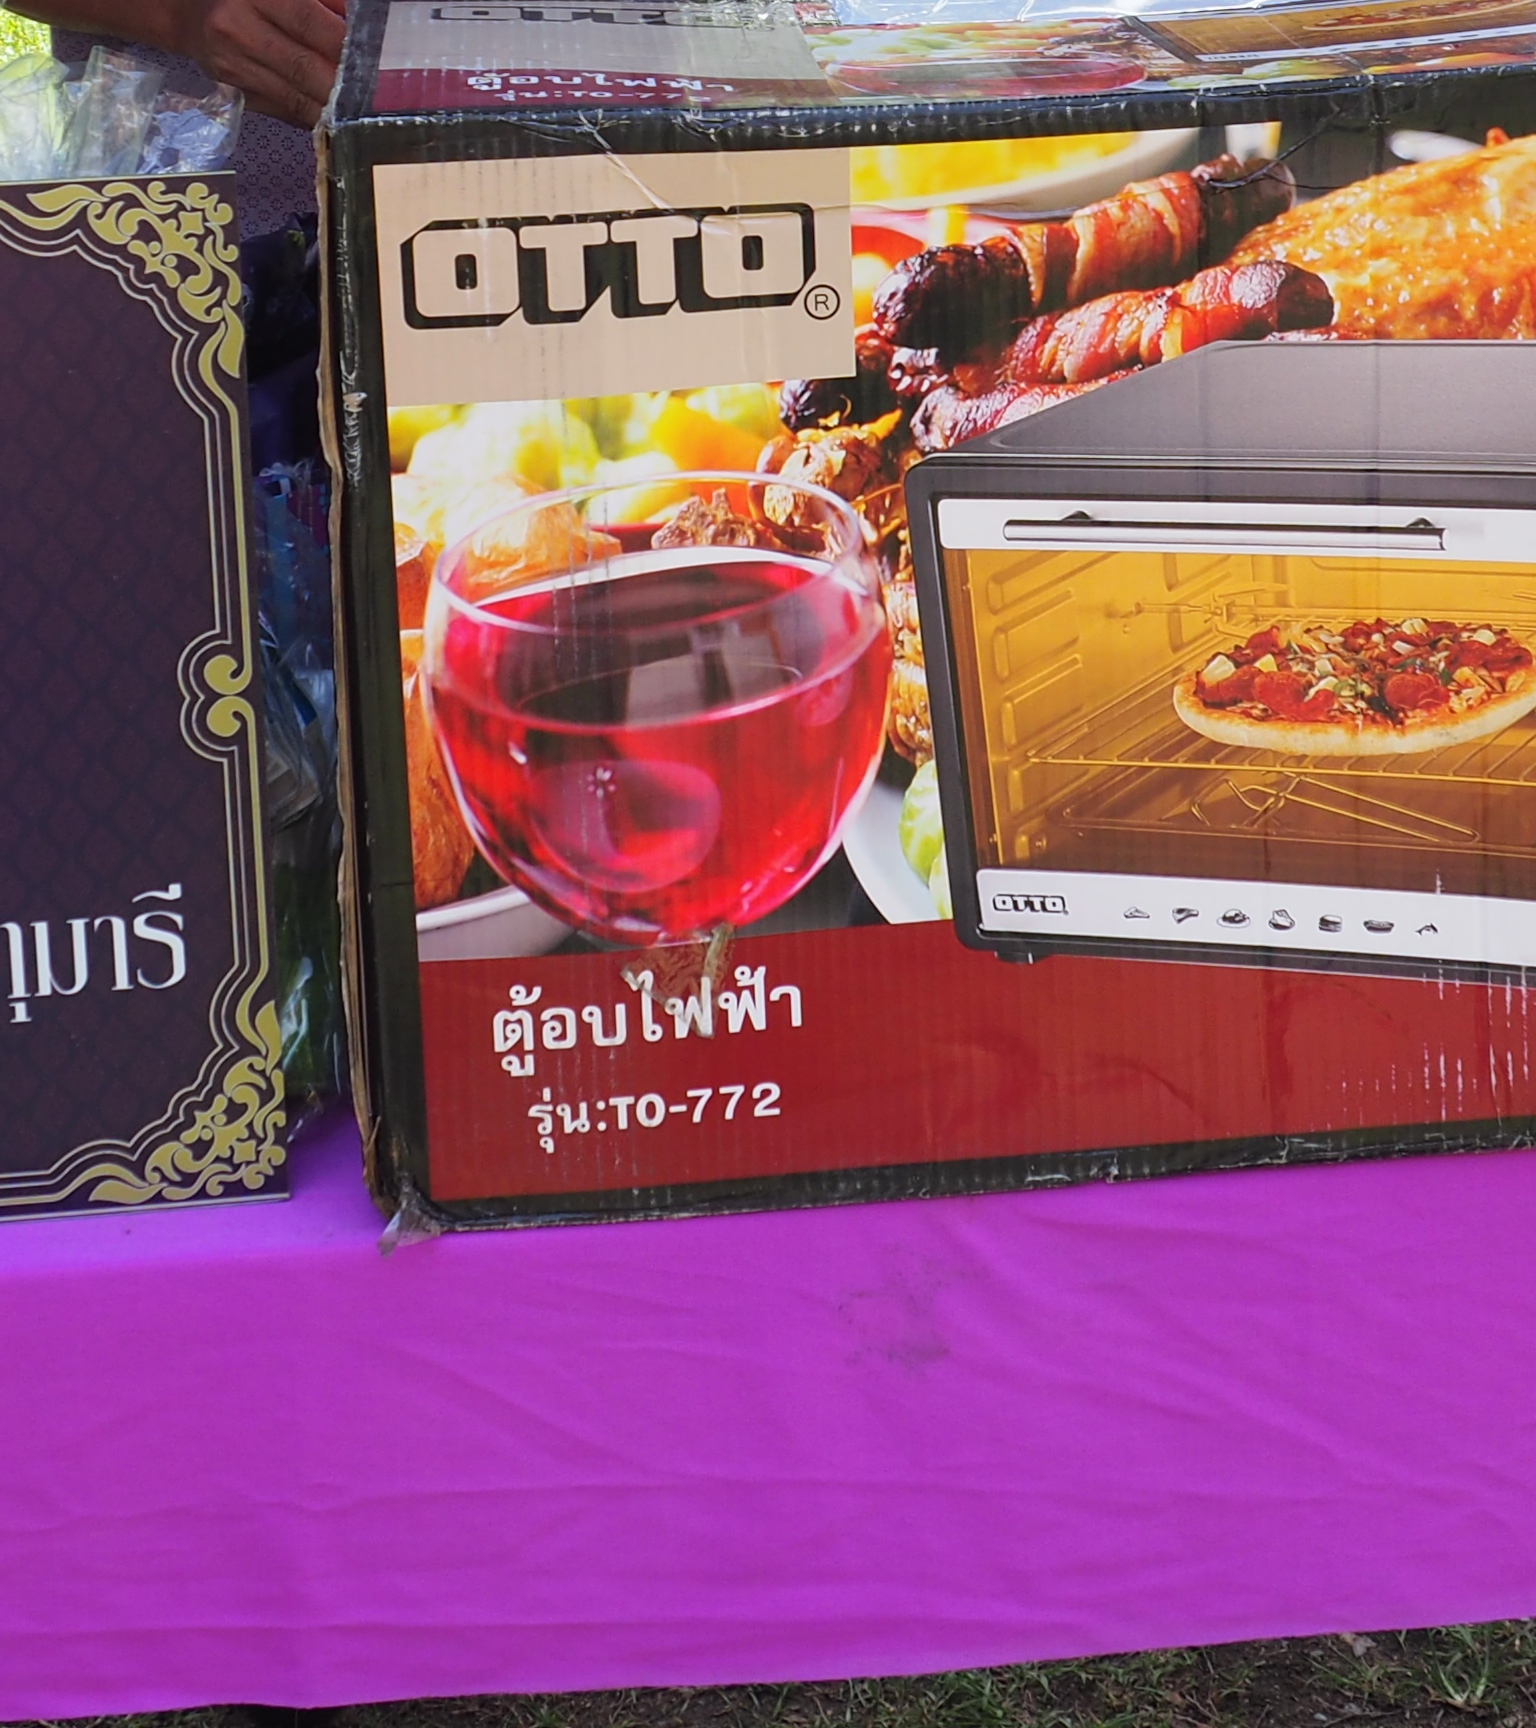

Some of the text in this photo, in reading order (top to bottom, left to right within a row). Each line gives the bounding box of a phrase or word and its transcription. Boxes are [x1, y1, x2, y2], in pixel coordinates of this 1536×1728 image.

[400, 202, 816, 330] OTTO
[992, 893, 1068, 915] OTTO
[492, 965, 803, 1077] ตู้อบไฟฟ้า
